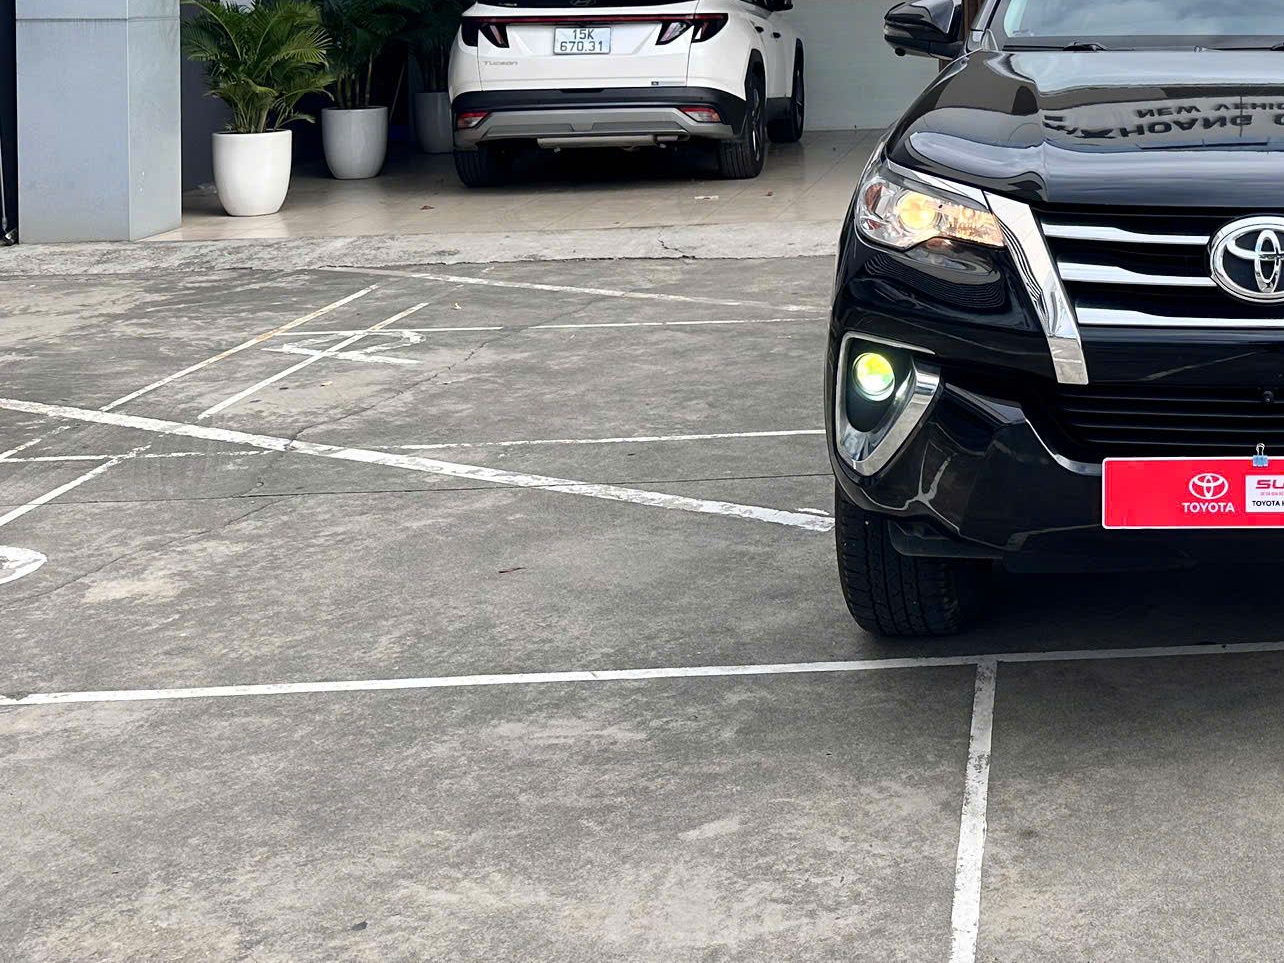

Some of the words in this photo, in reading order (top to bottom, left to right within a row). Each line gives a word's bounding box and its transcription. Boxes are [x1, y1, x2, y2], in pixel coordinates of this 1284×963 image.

[572, 28, 595, 40] 15K
[559, 40, 604, 52] 670.31
[1182, 502, 1235, 513] TOYOTA
